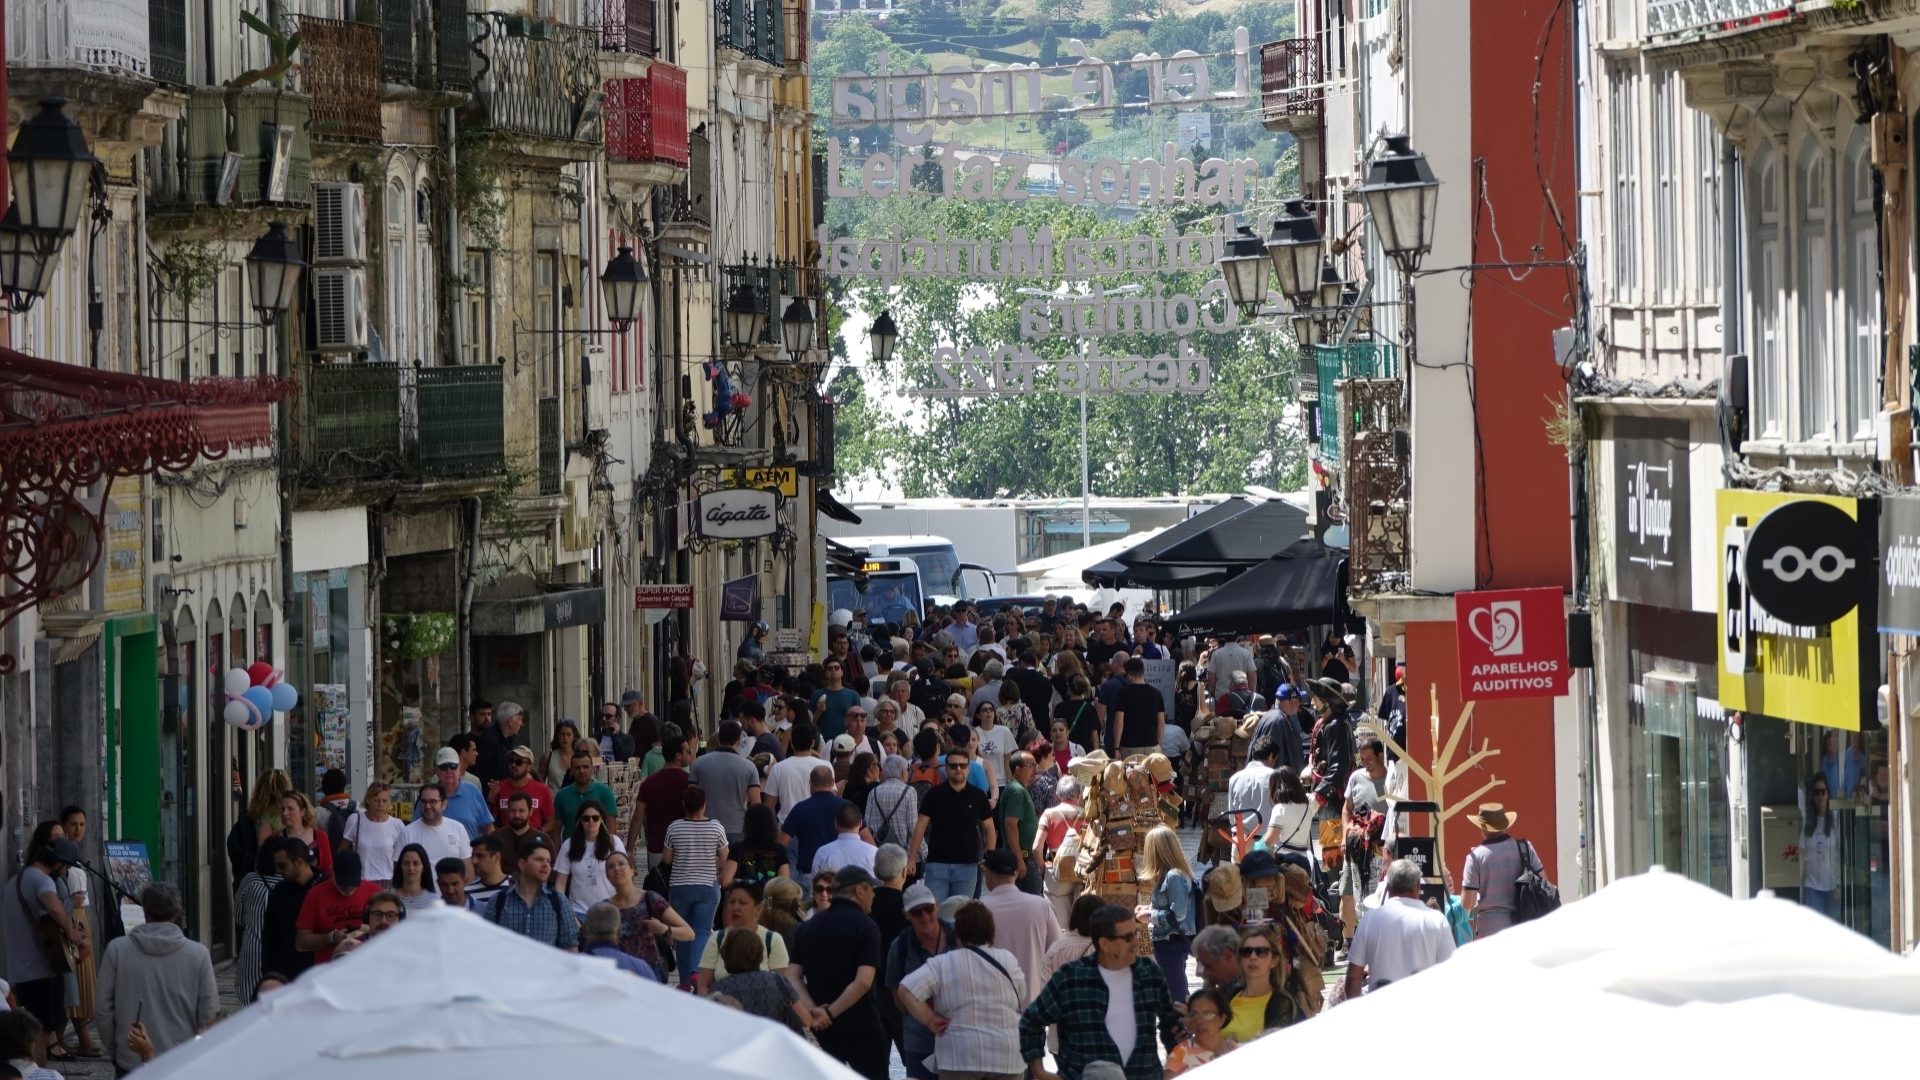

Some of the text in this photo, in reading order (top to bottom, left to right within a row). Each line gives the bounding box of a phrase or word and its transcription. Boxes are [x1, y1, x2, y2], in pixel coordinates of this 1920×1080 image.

[827, 137, 1259, 203] Ler faz sonhar
[753, 471, 790, 482] ATM
[637, 586, 661, 594] SUPER
[1471, 660, 1558, 676] APARELHOS
[1472, 677, 1553, 692] AUDITIVOS
